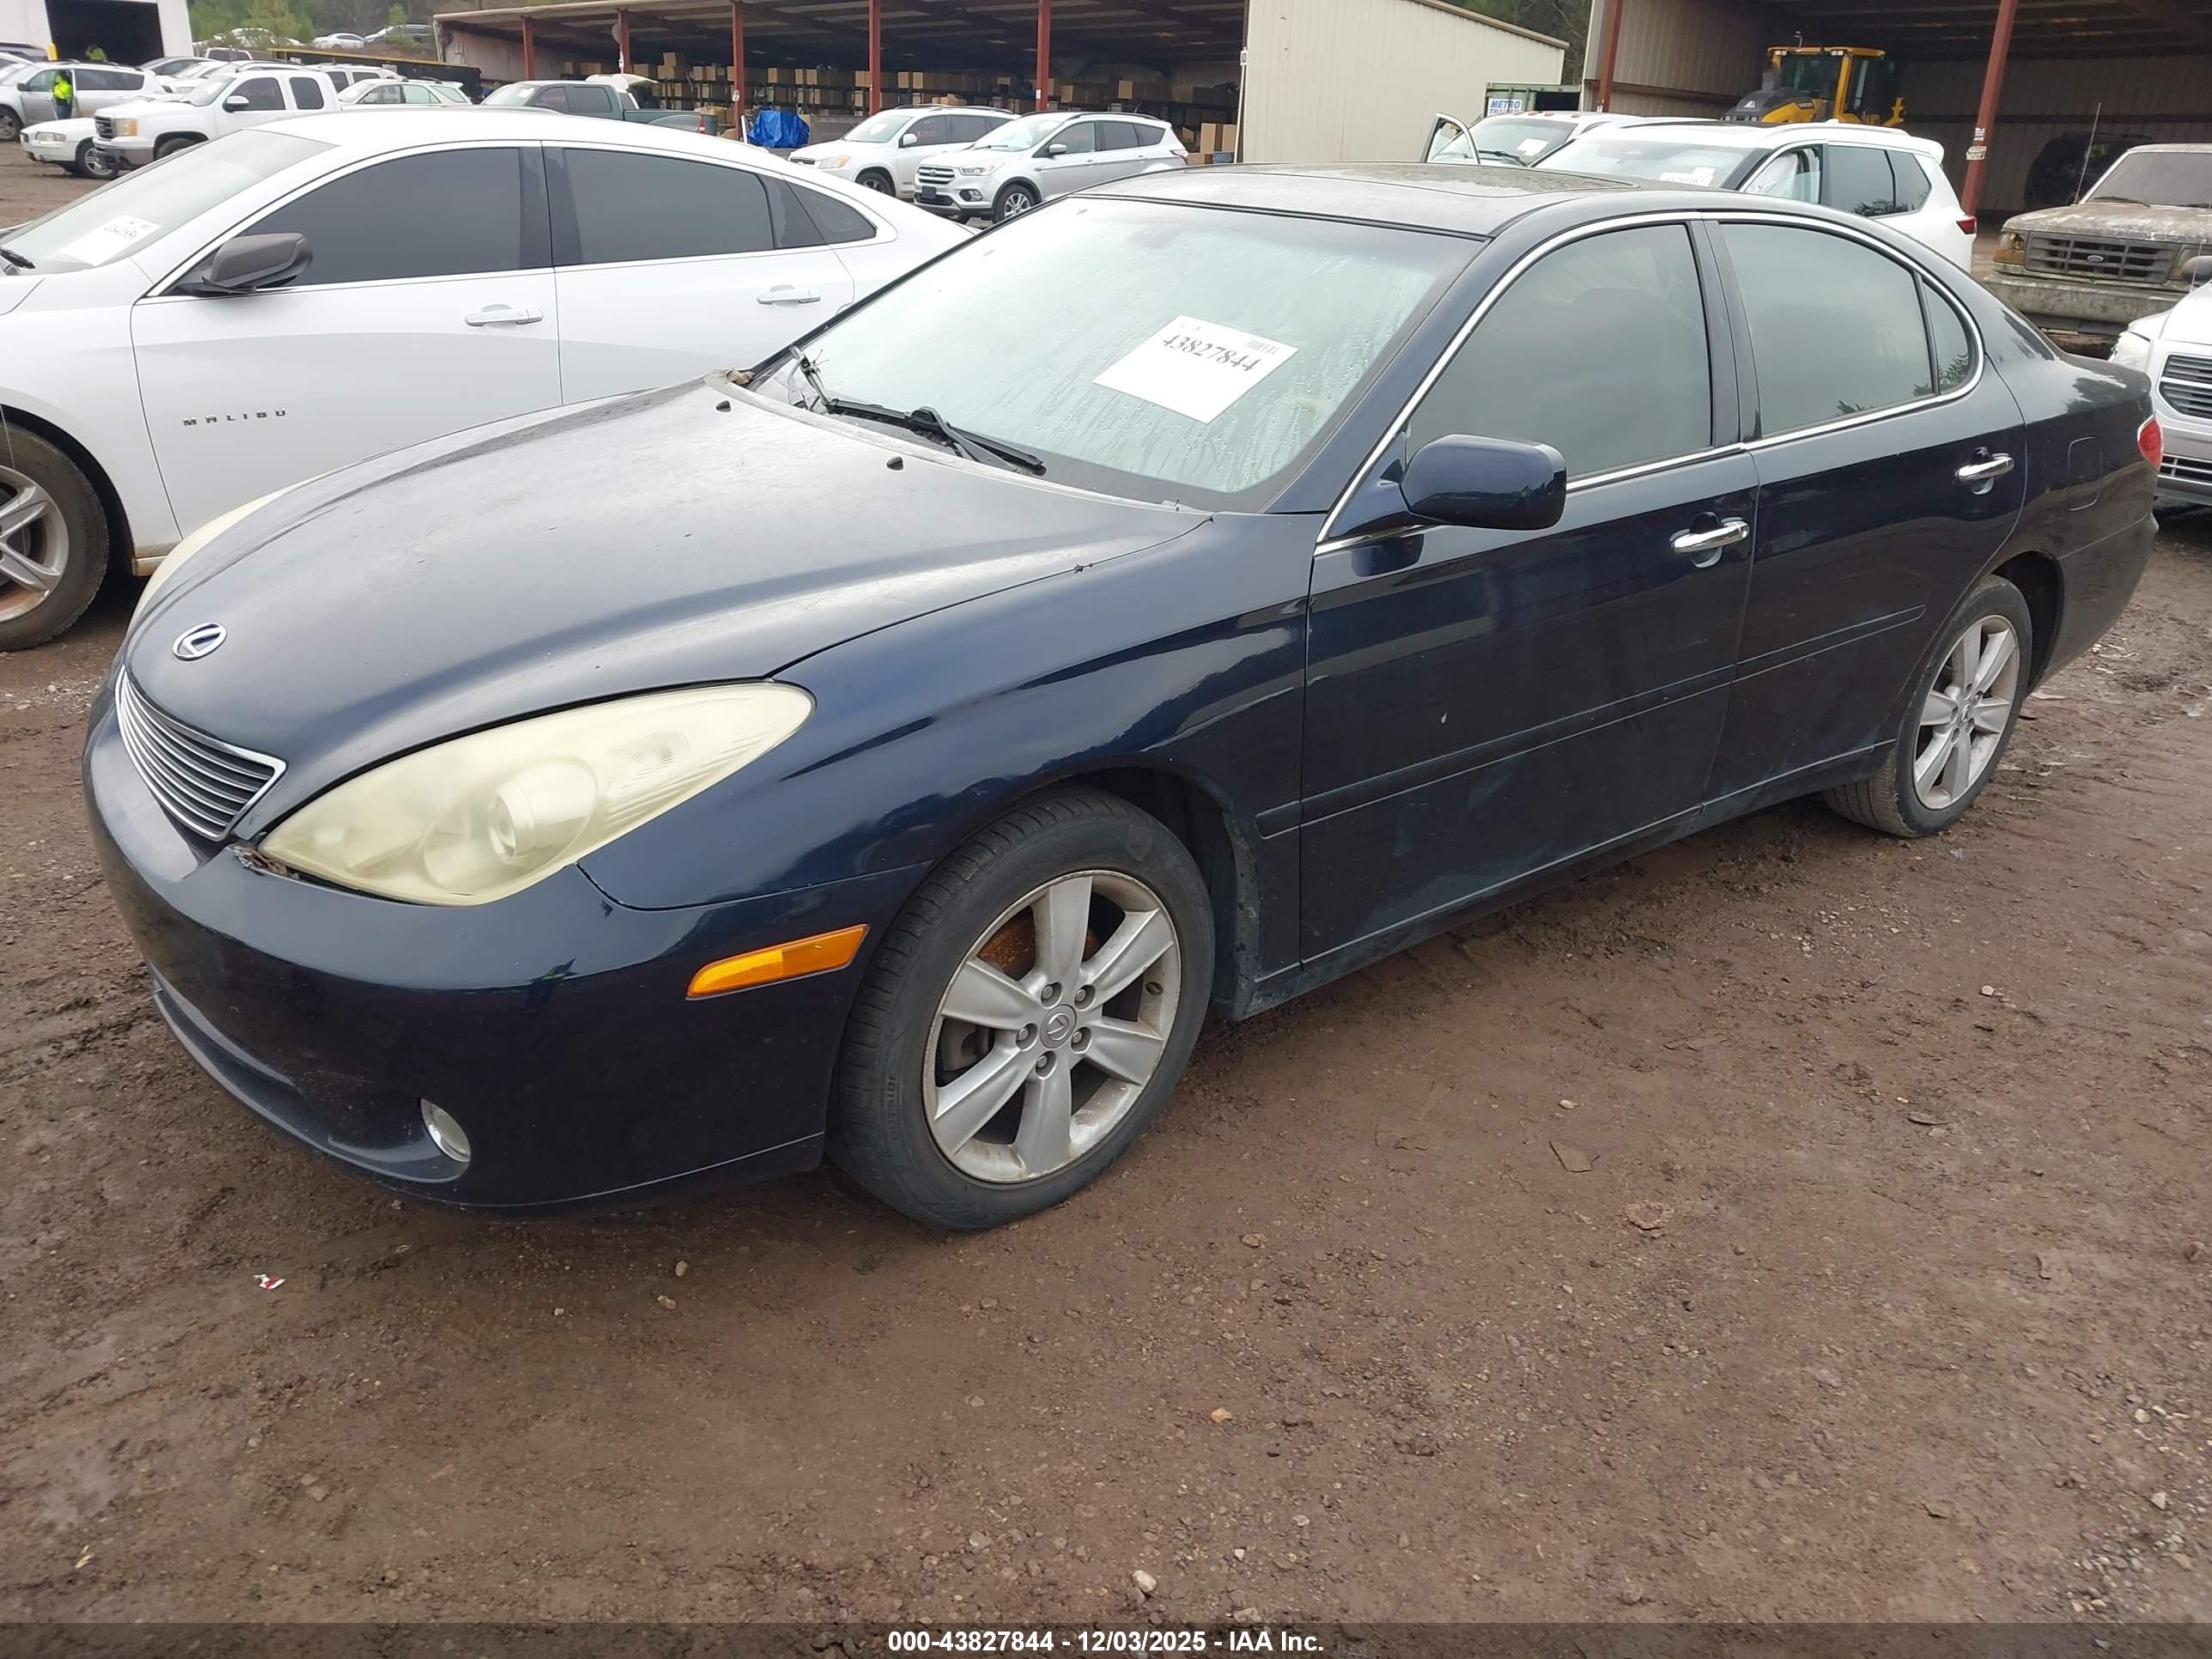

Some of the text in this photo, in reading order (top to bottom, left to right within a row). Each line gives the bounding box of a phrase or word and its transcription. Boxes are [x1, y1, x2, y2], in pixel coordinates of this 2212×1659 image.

[1491, 100, 1521, 108] METRO
[1163, 334, 1261, 372] 43827844
[183, 408, 286, 426] MALIBU
